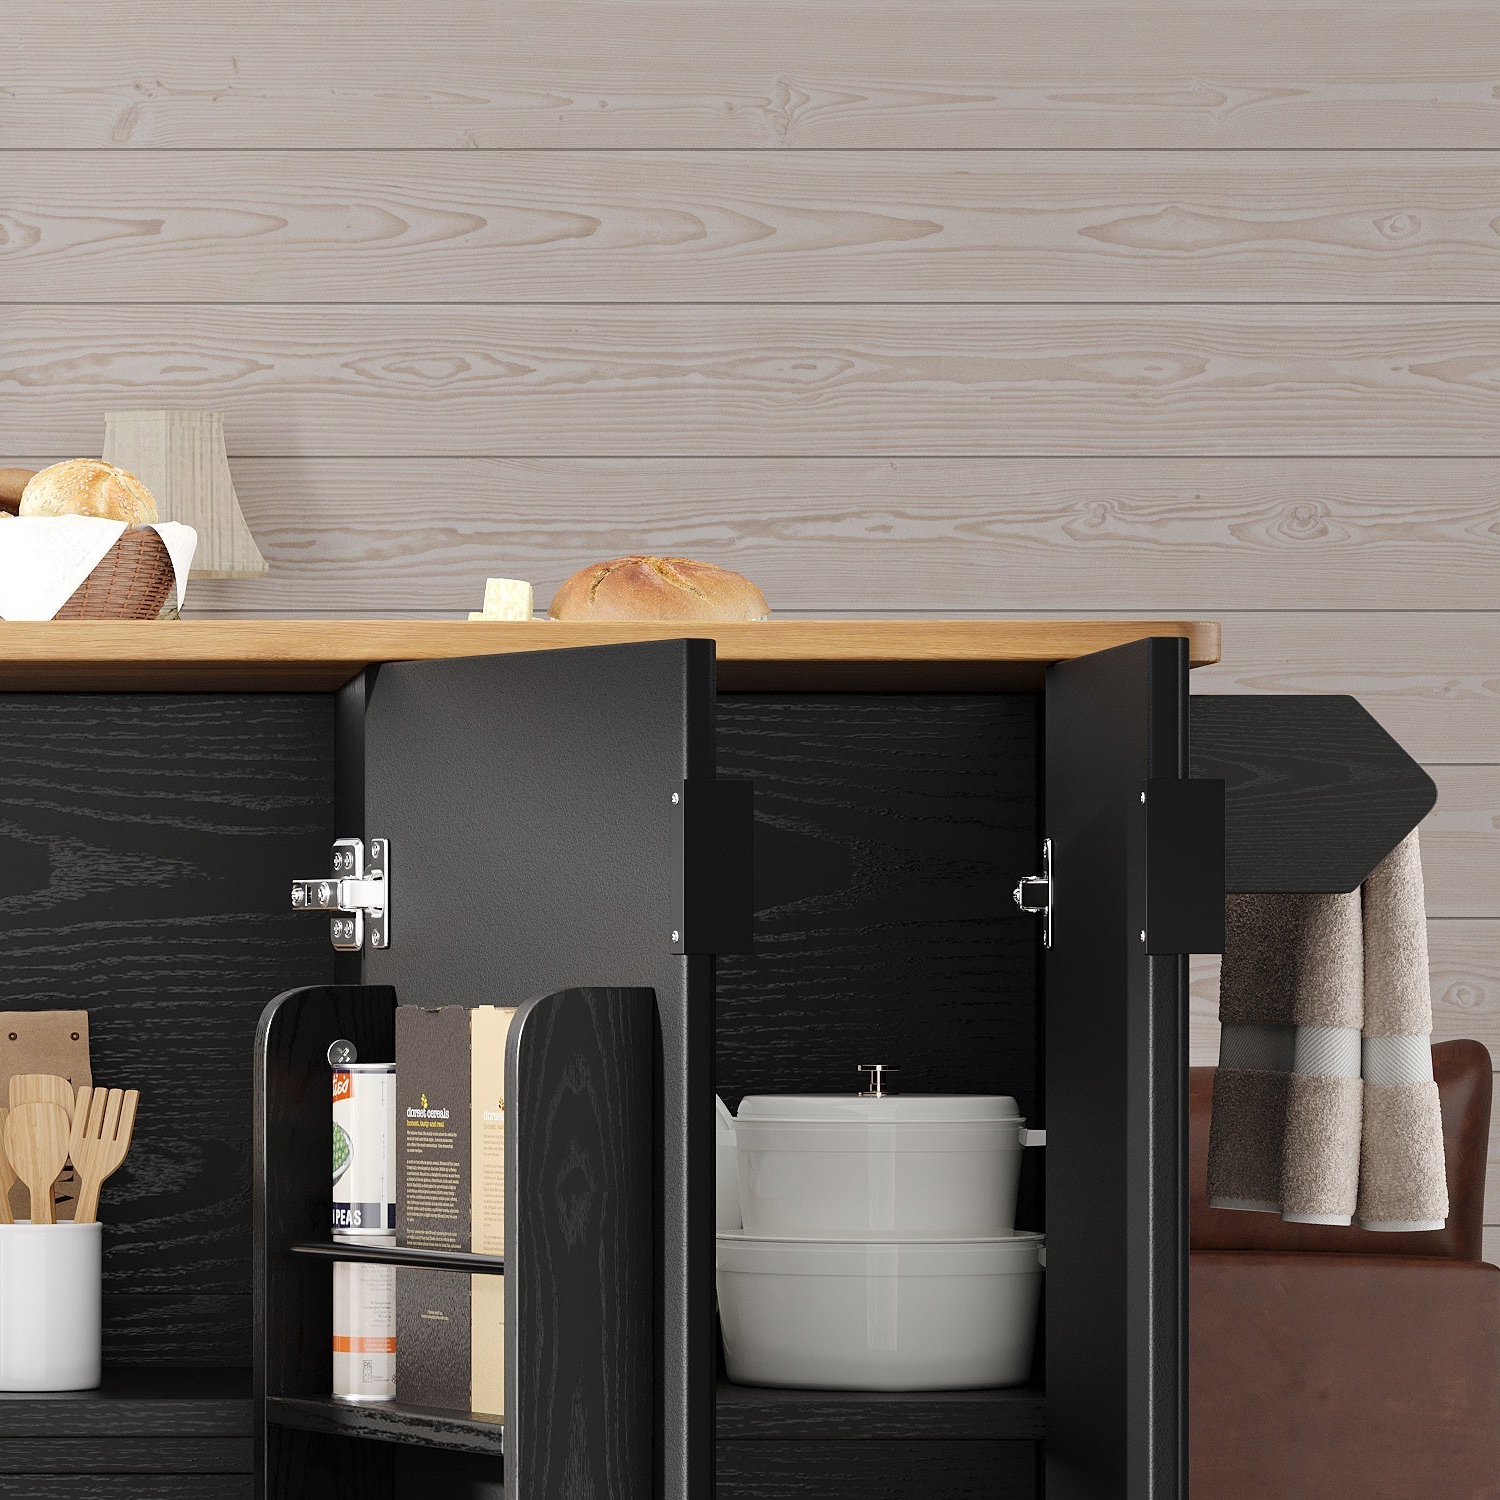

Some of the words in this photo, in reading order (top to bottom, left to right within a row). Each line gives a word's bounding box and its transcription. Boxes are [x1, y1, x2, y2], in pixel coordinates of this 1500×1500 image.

[406, 1107, 426, 1118] dorset
[427, 1108, 449, 1119] cereals
[336, 1209, 362, 1226] PEAS
